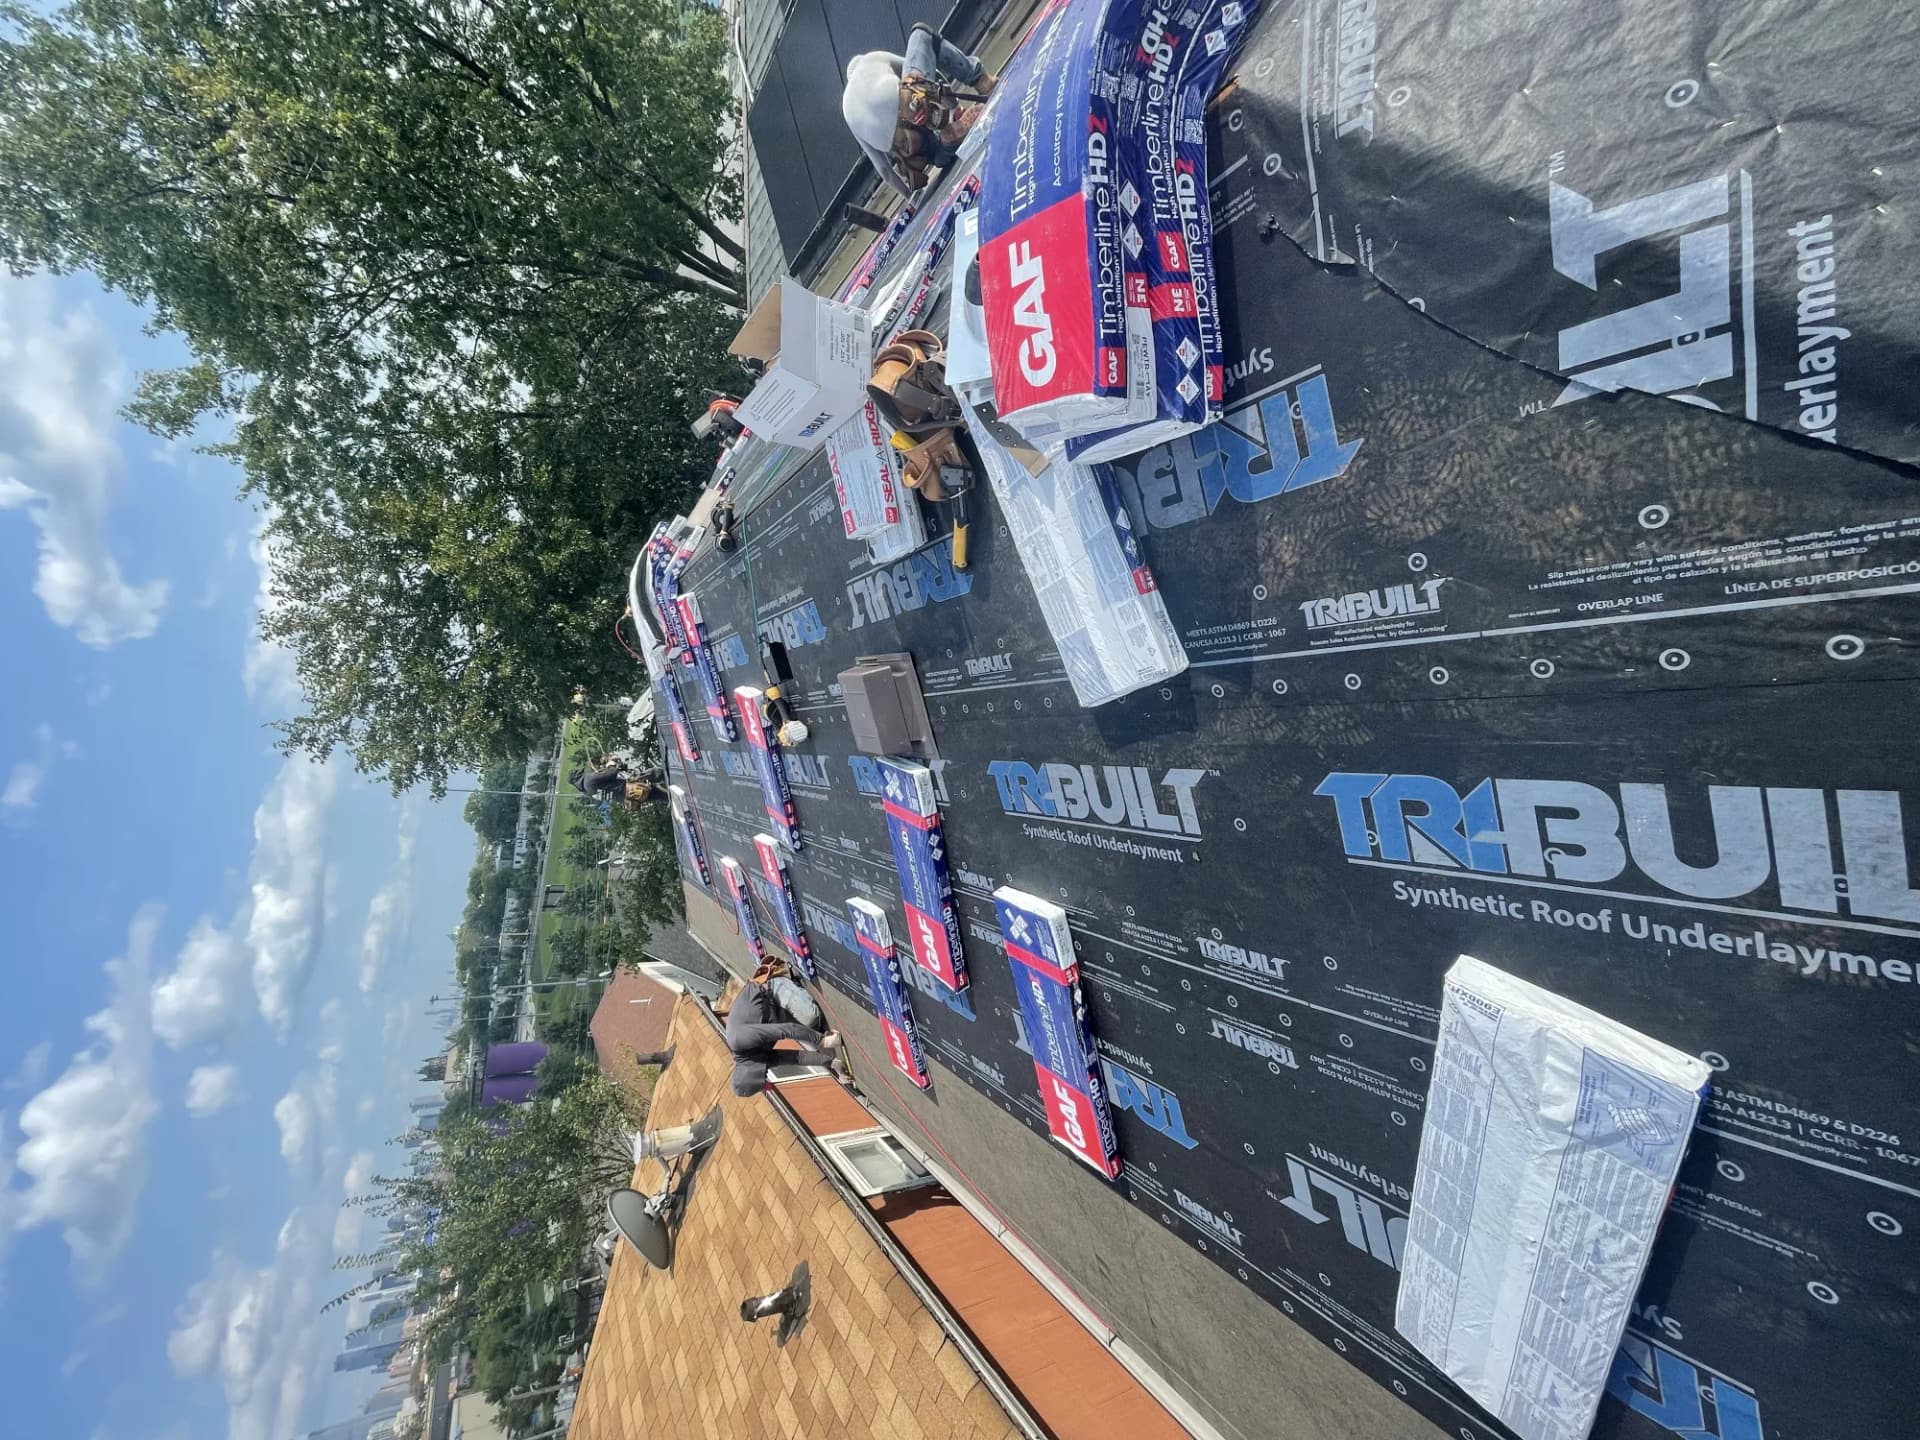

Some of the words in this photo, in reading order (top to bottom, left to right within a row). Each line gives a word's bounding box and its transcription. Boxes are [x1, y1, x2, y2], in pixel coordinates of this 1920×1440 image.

[1053, 110, 1062, 188] Accuracy
[1164, 235, 1180, 269] GAF
[1008, 239, 1057, 387] GAF
[1136, 278, 1147, 304] NE
[1171, 288, 1183, 312] NE
[1784, 214, 1851, 443] erlayment
[1107, 350, 1118, 384] GAF
[828, 448, 848, 508] SEAL
[1528, 583, 1538, 591] La
[1540, 578, 1585, 589] resistencia
[1661, 560, 1693, 573] puede
[1695, 556, 1725, 567] variar
[1728, 551, 1762, 563] según
[1765, 548, 1783, 556] las
[1785, 537, 1860, 553] condiciones
[1863, 533, 1880, 543] de
[1883, 531, 1896, 539] la
[1547, 571, 1565, 580] Slip
[1565, 564, 1610, 577] resistance
[1611, 561, 1631, 572] may
[1633, 558, 1653, 567] vary
[1655, 553, 1677, 563] with
[1679, 548, 1719, 559] surface
[1721, 538, 1784, 553] conditions,
[1785, 529, 1838, 543] weather,
[1840, 520, 1898, 535] footwear
[1644, 574, 1663, 584] tipo
[1664, 572, 1678, 580] de
[1679, 566, 1719, 579] calzado
[1721, 565, 1728, 575] y
[1730, 563, 1741, 571] la
[1743, 554, 1807, 570] inclinación
[1810, 551, 1830, 560] del
[1831, 546, 1868, 558] techo
[1298, 579, 1448, 628] TRIBUILT
[1577, 597, 1634, 612] OVERLAP
[1635, 593, 1665, 605] LINE
[1724, 581, 1769, 595] LÍNEA
[1771, 578, 1794, 590] DE
[1207, 625, 1229, 636] ASTM
[1257, 616, 1278, 627] D226
[1267, 627, 1287, 638] 1067
[1389, 630, 1398, 639] by
[964, 652, 1015, 676] TRIBUILT
[744, 700, 761, 739] GAF
[987, 760, 1206, 836] TRIBUILT
[1022, 823, 1067, 843] Synthetic
[1067, 831, 1093, 848] Roof
[1092, 835, 1183, 864] Underlayment
[1393, 880, 1525, 920] Synthetic
[1531, 900, 1613, 934] Roof
[916, 914, 941, 972] GAF
[1196, 936, 1290, 979] TRIBUILT
[1363, 1009, 1394, 1023] OVERLAP
[887, 1023, 909, 1071] GAF
[1103, 1039, 1154, 1075] Synthetic
[1208, 1018, 1300, 1070] TRIBUILT
[1051, 1078, 1087, 1150] GAF
[1726, 1087, 1772, 1110] ASTM
[1775, 1102, 1830, 1126] D4869
[1832, 1119, 1847, 1133] &
[1851, 1122, 1901, 1146] D226
[1736, 1106, 1792, 1131] A123.3
[1809, 1127, 1861, 1151] CCRR
[1308, 1143, 1413, 1201] erlayment
